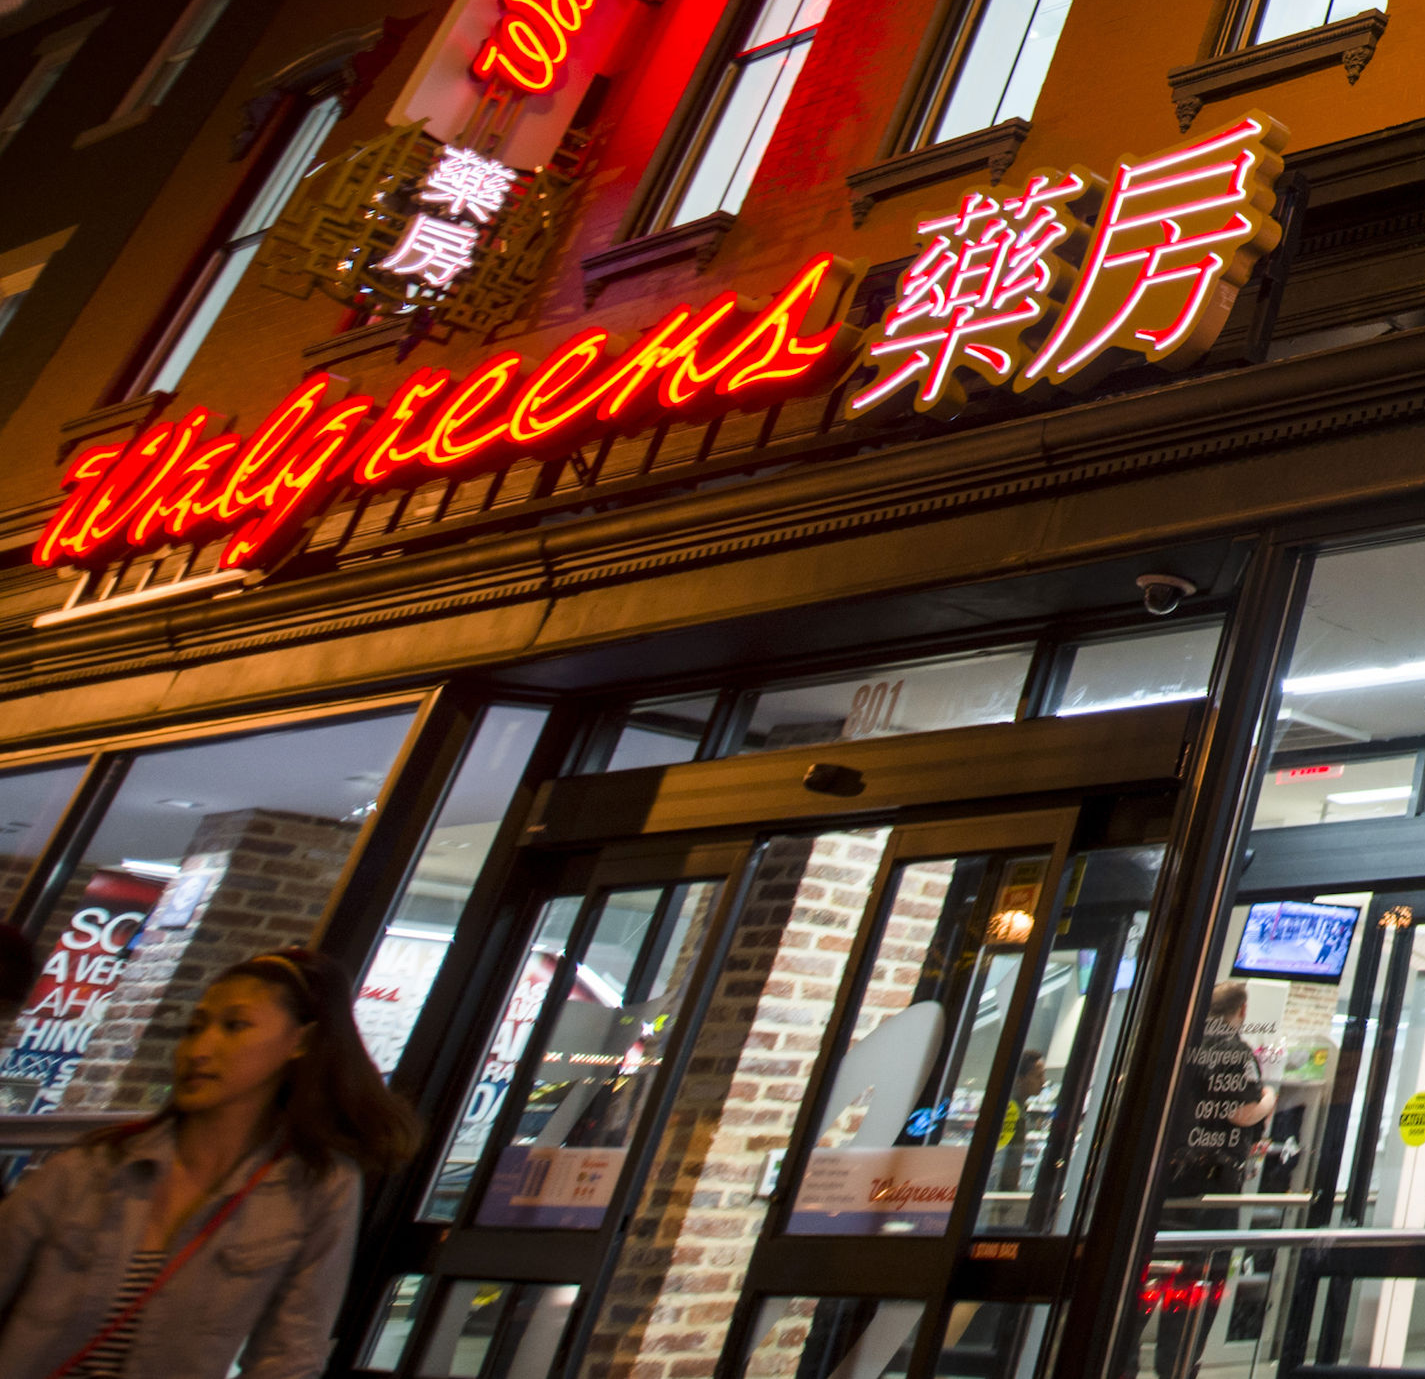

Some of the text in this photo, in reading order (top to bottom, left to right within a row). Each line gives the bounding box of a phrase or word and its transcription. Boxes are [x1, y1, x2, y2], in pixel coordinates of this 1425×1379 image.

[377, 143, 518, 287] 藥房
[850, 117, 1264, 410] 藥房
[34, 254, 846, 566] Walgreens
[841, 678, 906, 738] 801
[1204, 1016, 1278, 1041] Walgreens
[1187, 1126, 1241, 1148] Class B
[868, 1176, 959, 1212] Walgreens
